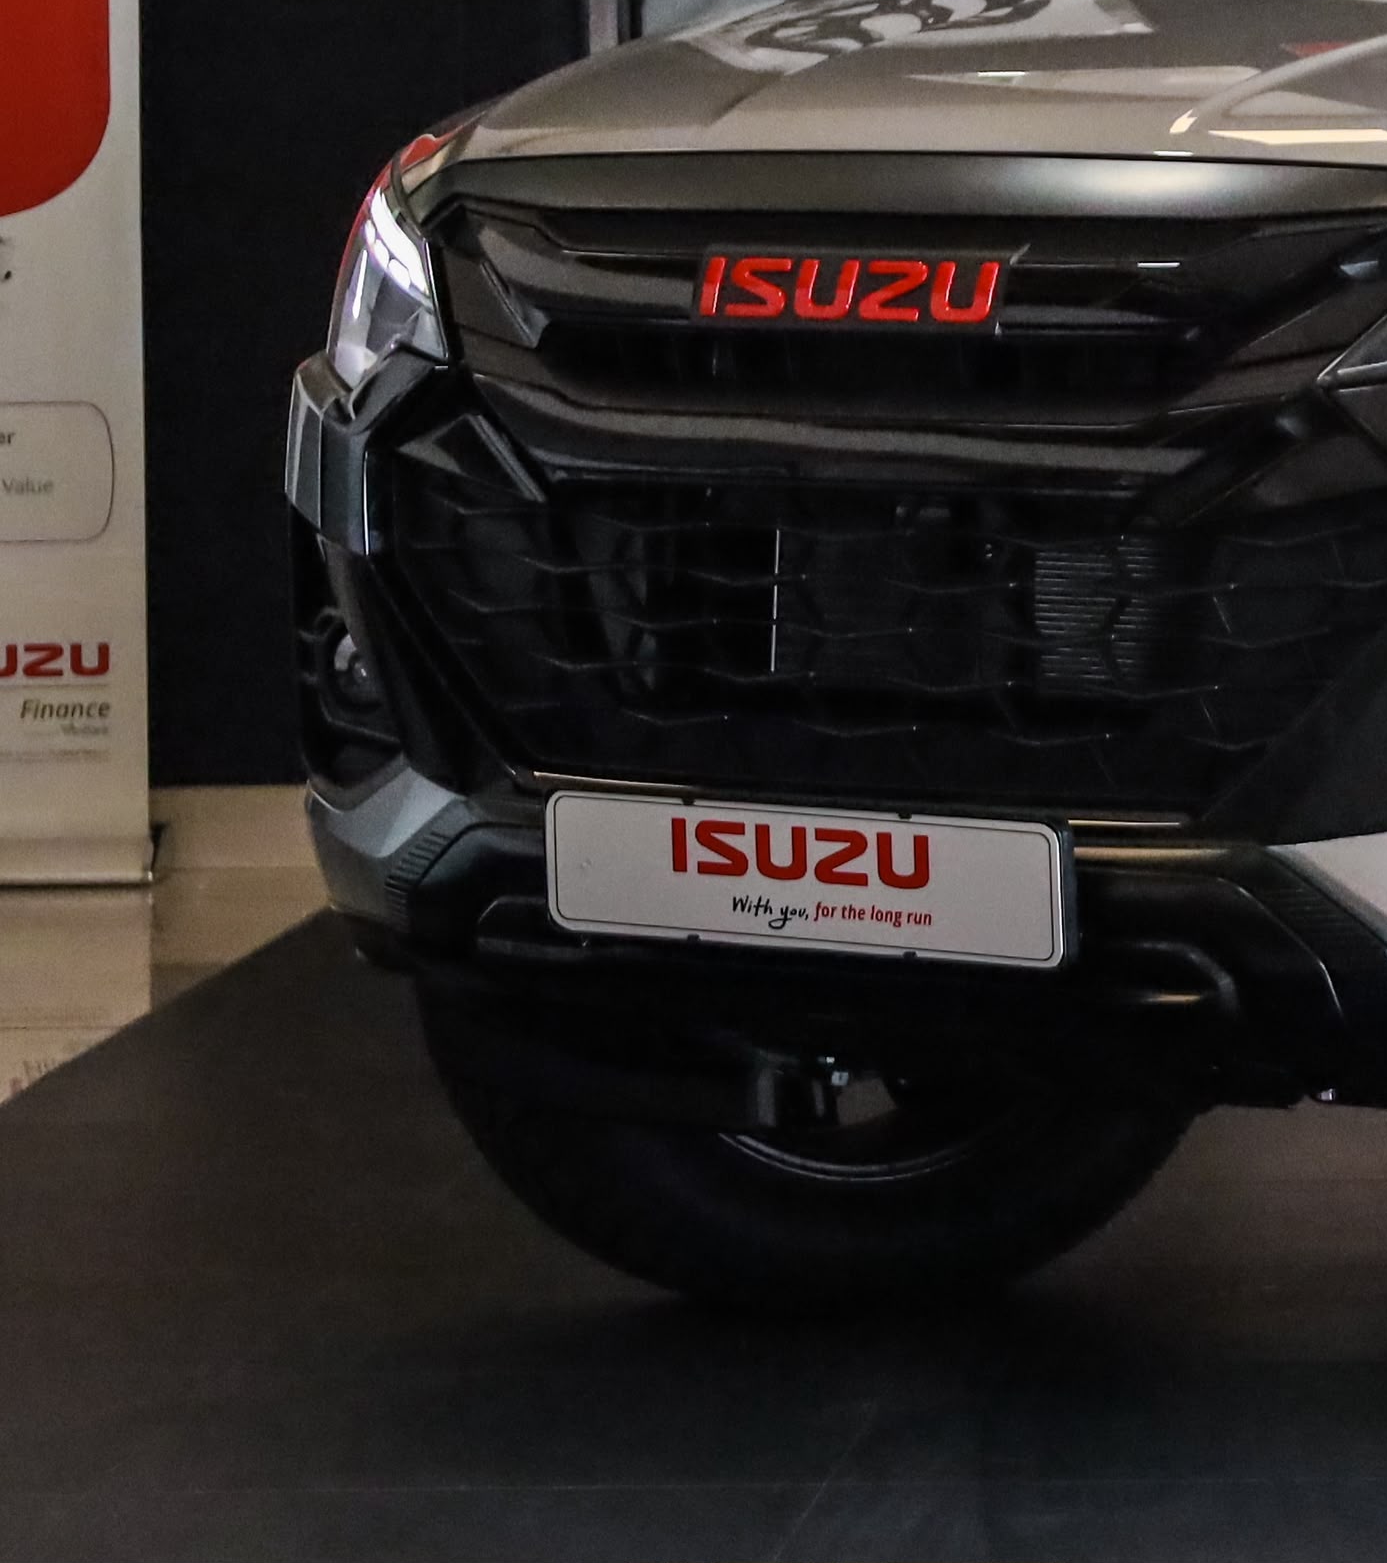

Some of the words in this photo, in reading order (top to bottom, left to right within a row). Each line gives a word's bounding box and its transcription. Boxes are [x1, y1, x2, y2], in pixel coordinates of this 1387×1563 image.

[700, 255, 1001, 324] ISUZU
[2, 478, 54, 495] Value
[20, 699, 111, 719] Finance
[671, 817, 931, 890] ISUZU
[731, 895, 773, 917] With
[768, 904, 809, 930] you,
[813, 901, 837, 922] for
[841, 903, 867, 922] the
[869, 904, 902, 928] long
[906, 908, 933, 926] run
